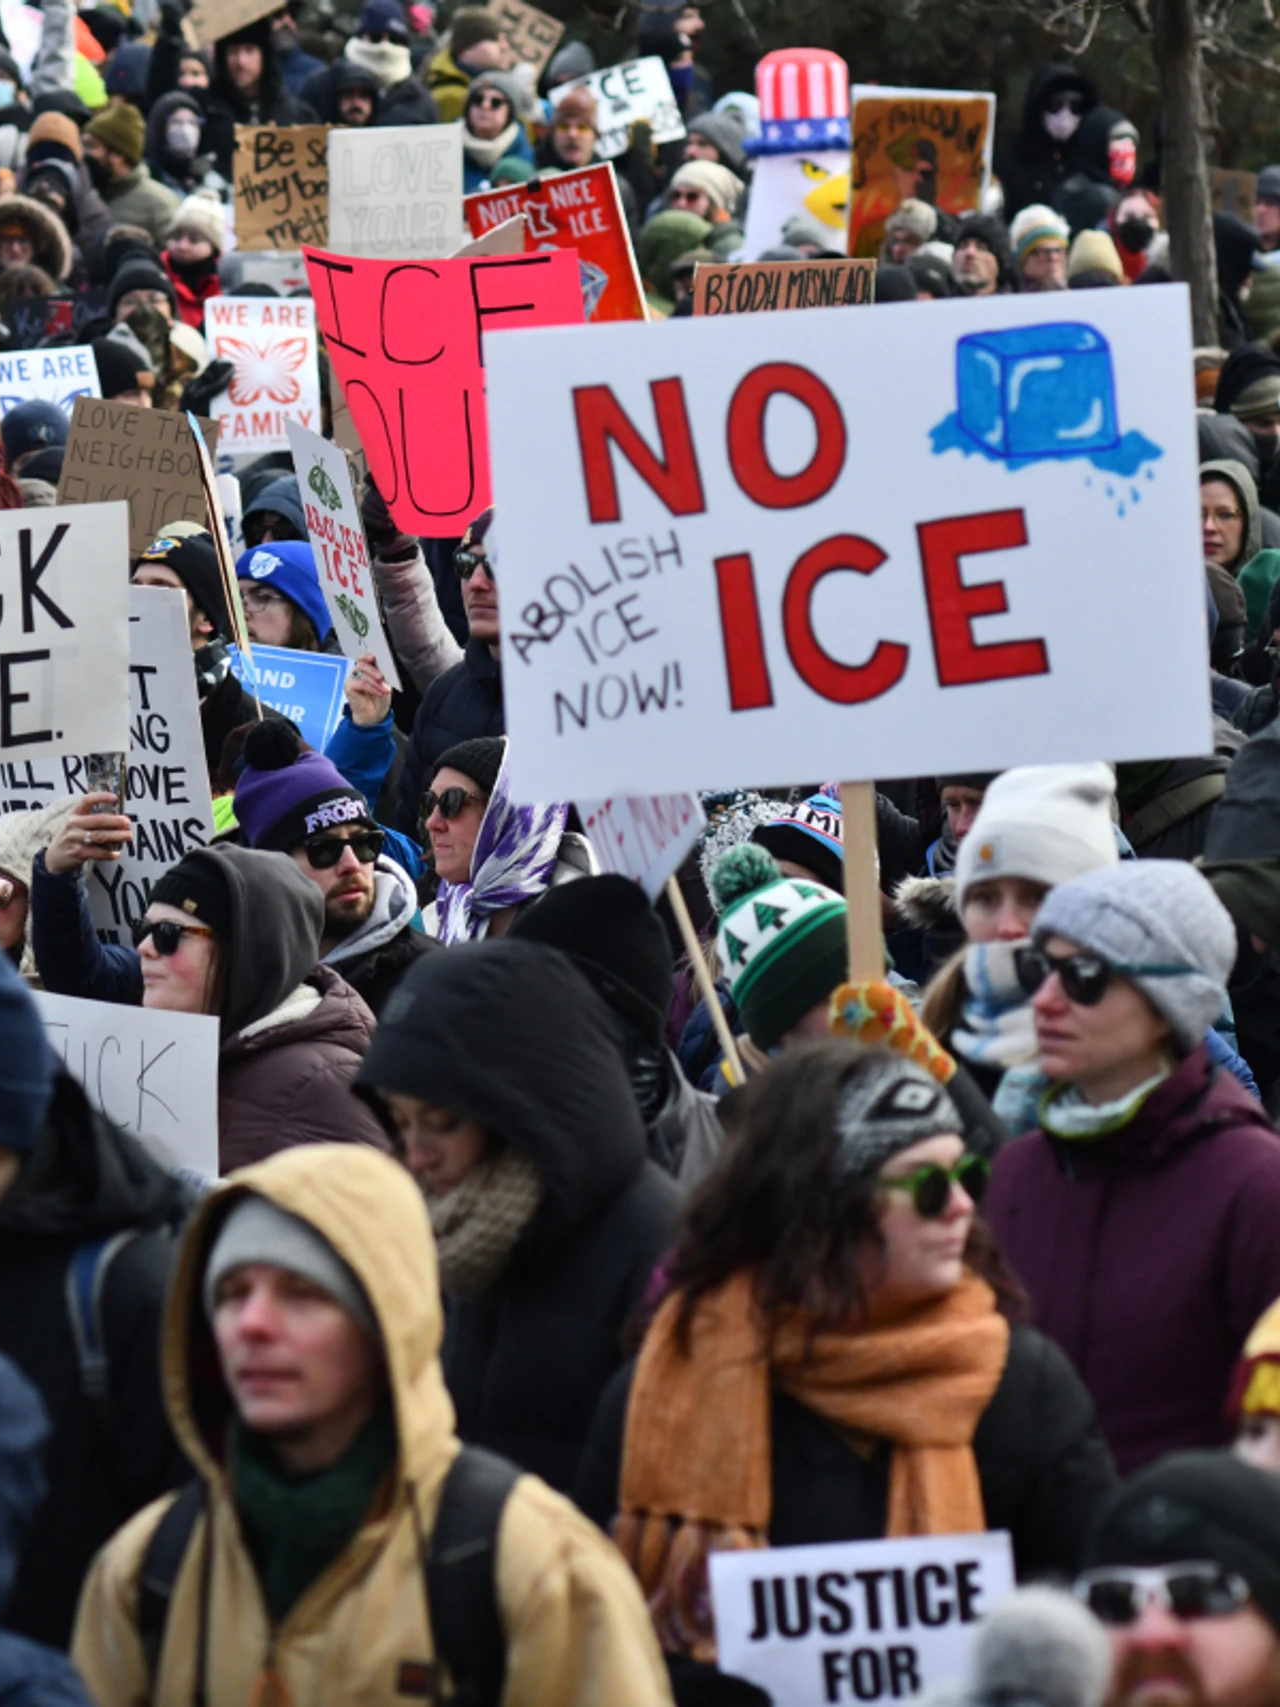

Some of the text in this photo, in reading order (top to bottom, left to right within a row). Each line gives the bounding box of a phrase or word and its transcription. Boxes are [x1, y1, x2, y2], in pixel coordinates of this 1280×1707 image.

[594, 63, 646, 100] CE
[254, 131, 294, 174] Be
[343, 140, 454, 198] LOVE
[238, 173, 291, 216] they
[477, 178, 596, 228] NOT NICE
[344, 202, 448, 254] YOUR
[569, 208, 610, 238] ICE
[212, 303, 308, 327] WE ARE
[43, 353, 90, 379] ARE
[76, 403, 140, 437] LOVE
[218, 409, 313, 439] FAMIY
[572, 360, 848, 525] NO
[346, 379, 487, 516] OU
[305, 503, 368, 567] ABOLISH
[321, 543, 364, 597] ICE
[509, 529, 683, 666] ABOLISH
[713, 506, 1050, 713] ICE
[575, 593, 658, 665] ICE
[230, 665, 295, 689] SAND
[554, 660, 683, 735] NOW!
[62, 754, 190, 804] ROVE
[43, 1022, 180, 1132] UCK
[748, 1560, 984, 1642] JUSTICE
[822, 1644, 921, 1706] FOR
